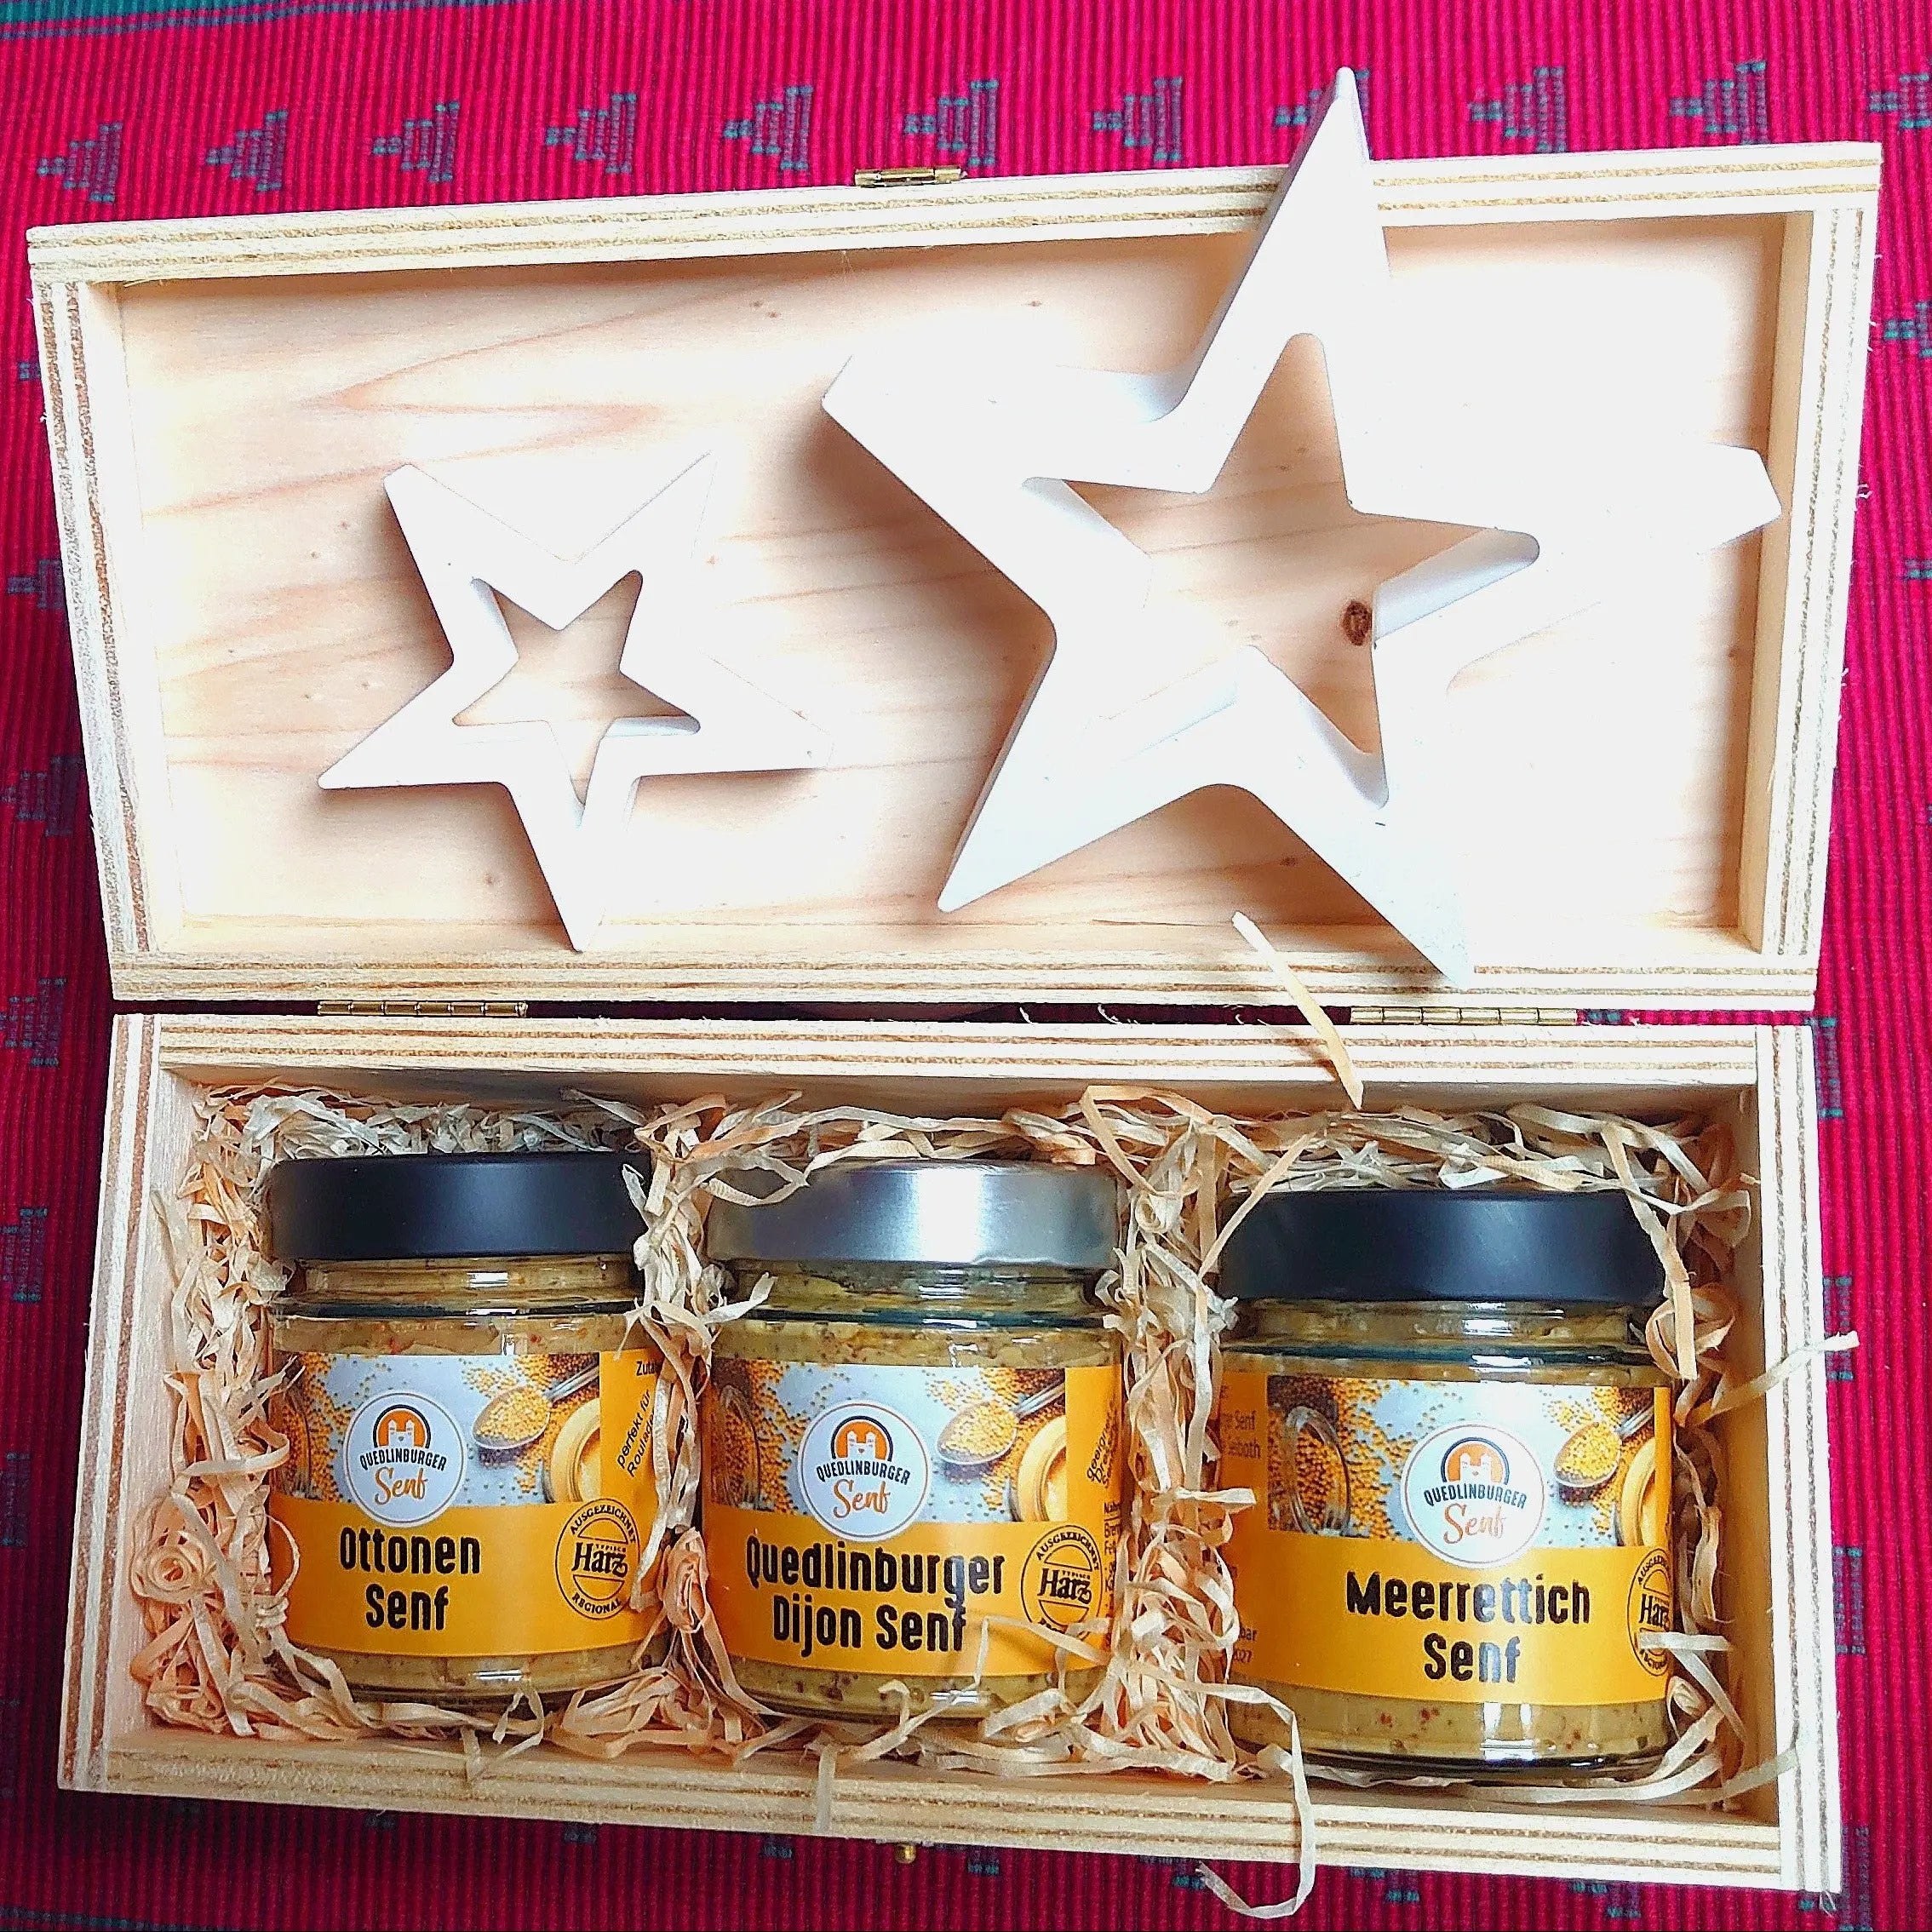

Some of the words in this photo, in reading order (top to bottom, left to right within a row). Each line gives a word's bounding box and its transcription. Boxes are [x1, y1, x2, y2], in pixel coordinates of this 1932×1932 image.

[616, 1412, 644, 1469] perfekt
[639, 1389, 651, 1412] für
[359, 1448, 447, 1471] QUEDLINBURGER
[817, 1460, 910, 1485] QUEDLINBURGER
[375, 1465, 428, 1505] Senf
[832, 1480, 891, 1519] Senf
[1424, 1482, 1527, 1511] QUEDLINBURGER
[1442, 1503, 1506, 1545] Senf
[340, 1527, 481, 1575] Ottonen
[571, 1542, 628, 1578] Harz
[746, 1534, 1006, 1605] Quedlinburger
[572, 1592, 621, 1614] REGIONAL
[1037, 1568, 1092, 1604] Harz
[1345, 1571, 1590, 1625] Meerrettich
[365, 1584, 449, 1631] Senf
[773, 1594, 861, 1657] Dijon
[876, 1599, 966, 1653] Senf
[1424, 1632, 1521, 1683] Senf
